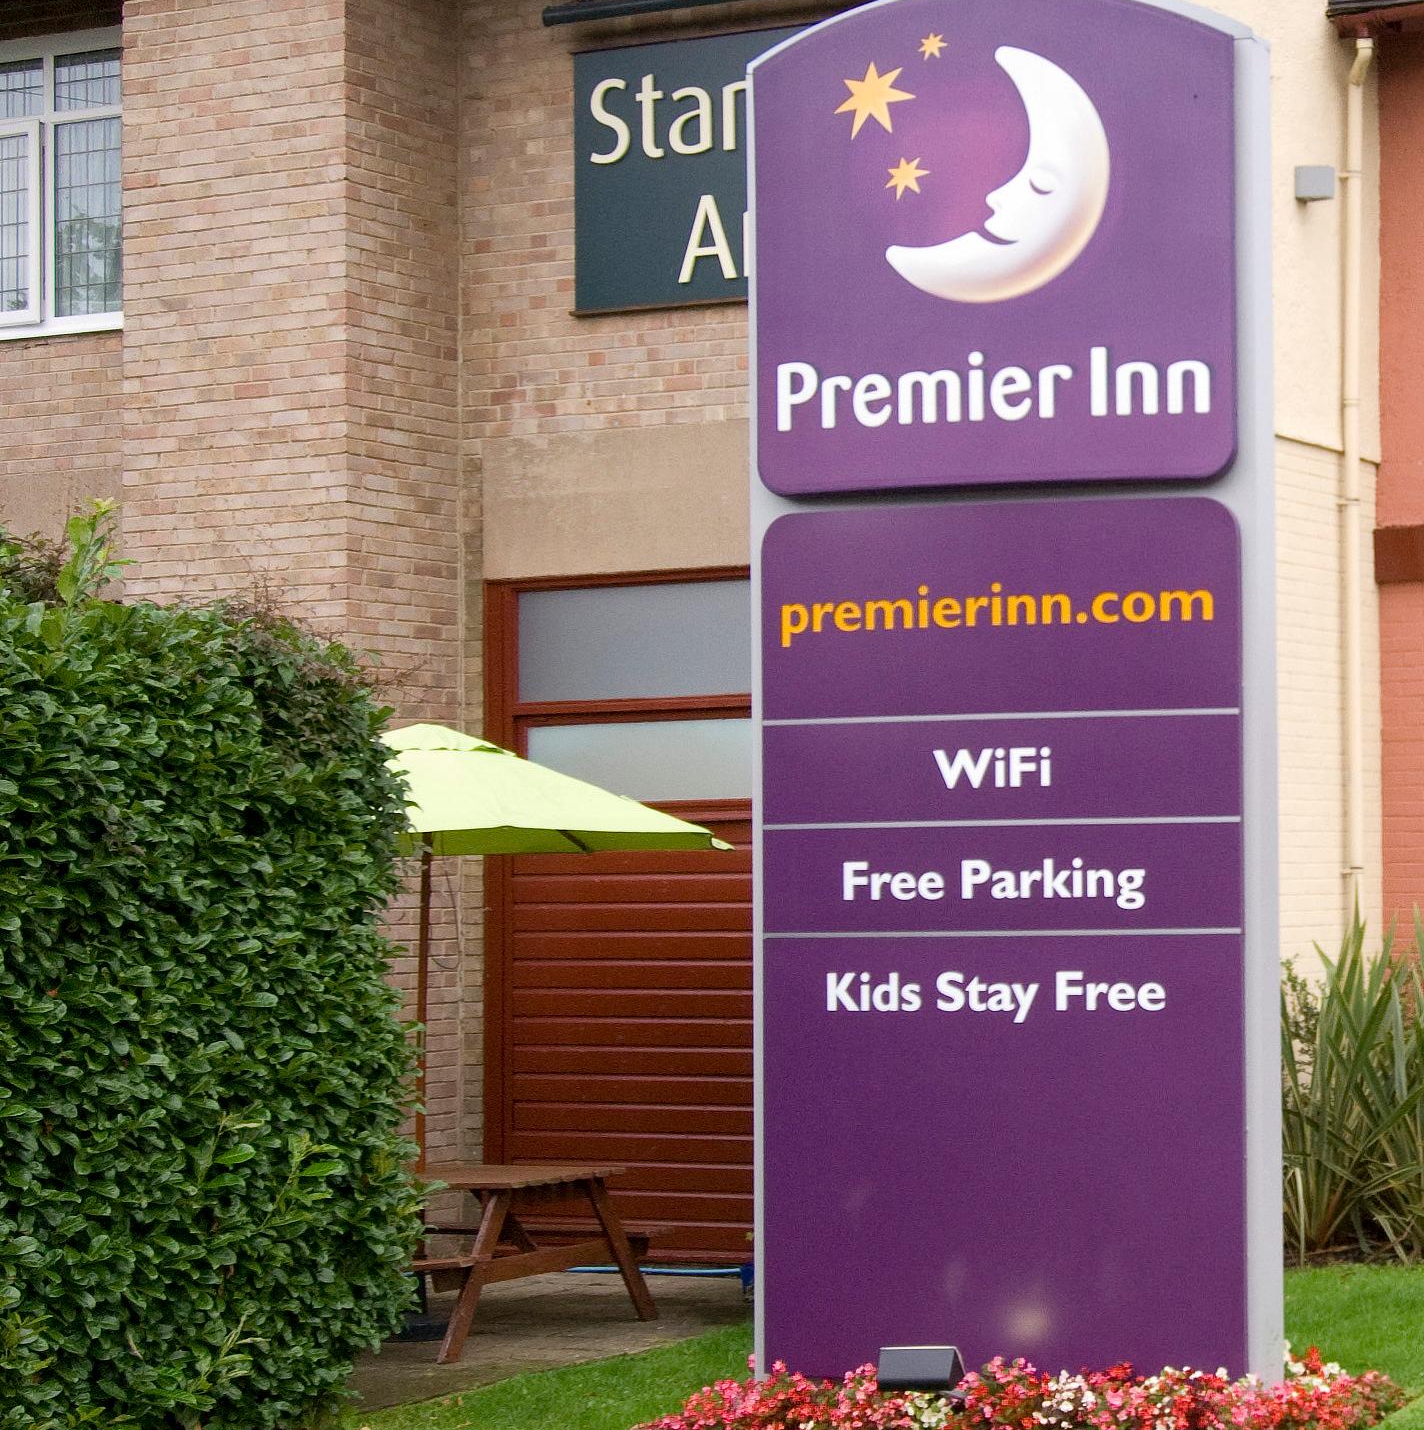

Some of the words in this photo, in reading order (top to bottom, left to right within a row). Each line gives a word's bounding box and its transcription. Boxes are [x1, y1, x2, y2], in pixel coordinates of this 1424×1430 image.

[776, 350, 1073, 432] Premier
[1089, 346, 1211, 417] Inn
[780, 581, 1215, 648] premierinn.com
[932, 746, 1051, 789] WiFi
[843, 861, 945, 901] Free
[961, 857, 1146, 910] Parking
[826, 972, 922, 1012] Kids
[936, 971, 1039, 1024] Stay
[1055, 970, 1166, 1012] Free
